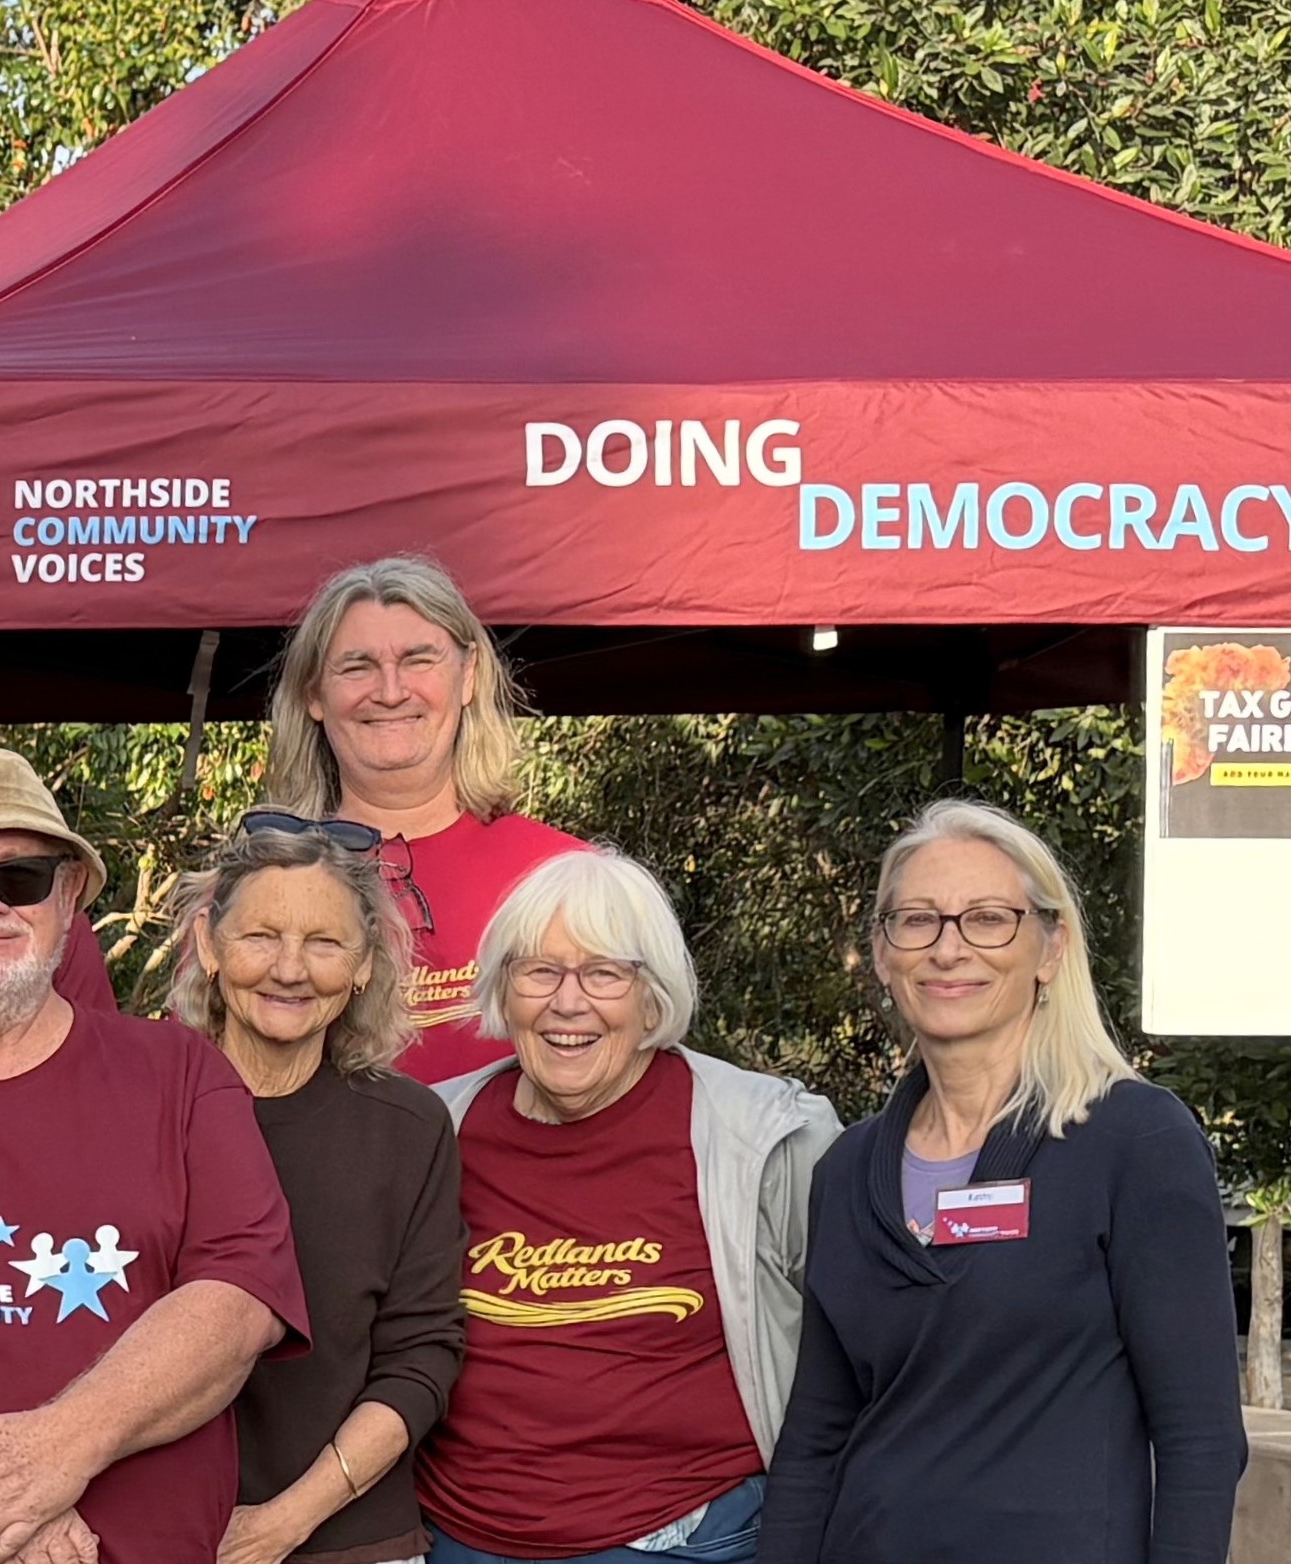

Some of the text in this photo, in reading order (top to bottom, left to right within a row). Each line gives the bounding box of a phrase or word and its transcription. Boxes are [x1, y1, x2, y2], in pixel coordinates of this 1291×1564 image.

[525, 418, 801, 487] DOING
[14, 478, 230, 509] NORTHSIDE
[12, 515, 257, 546] COMMUNITY
[11, 553, 145, 583] VOICES
[1199, 689, 1264, 719] TAX
[469, 1231, 662, 1275] Redlands
[499, 1267, 632, 1295] Matters
